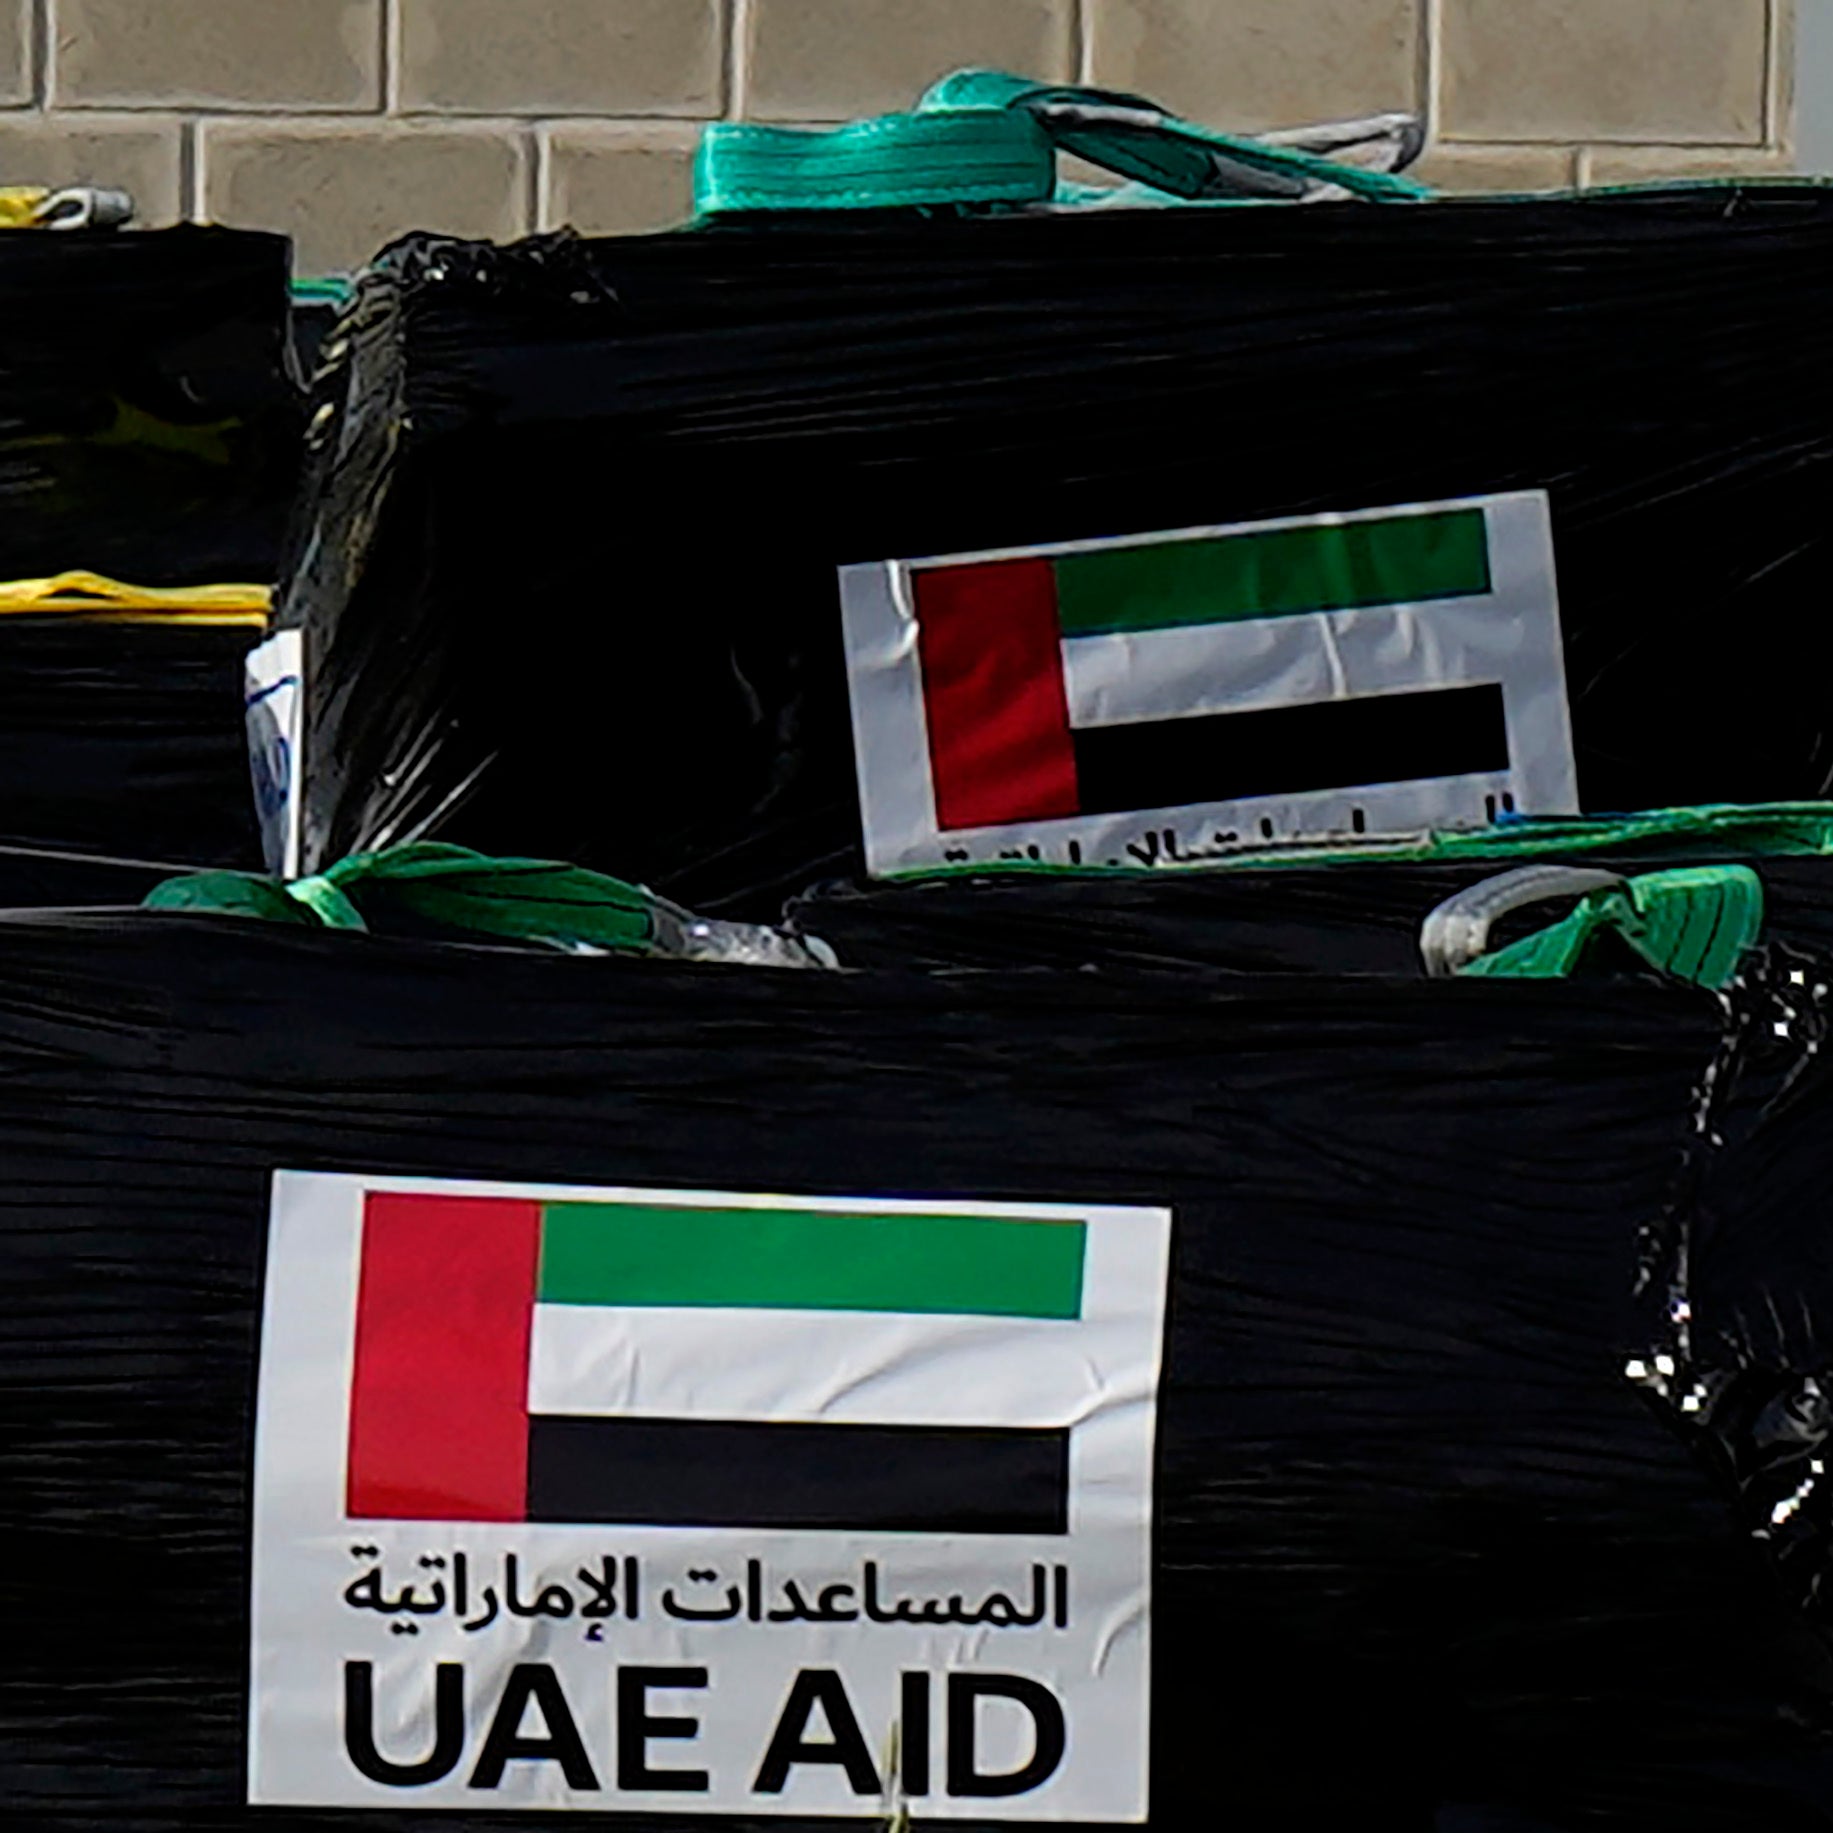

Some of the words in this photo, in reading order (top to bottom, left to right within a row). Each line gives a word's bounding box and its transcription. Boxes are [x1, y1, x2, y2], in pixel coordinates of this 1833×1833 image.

[344, 1546, 639, 1641] الإماراتية
[661, 1558, 1068, 1629] المساعدات
[344, 1660, 709, 1792] UAE
[753, 1669, 1066, 1798] AID
